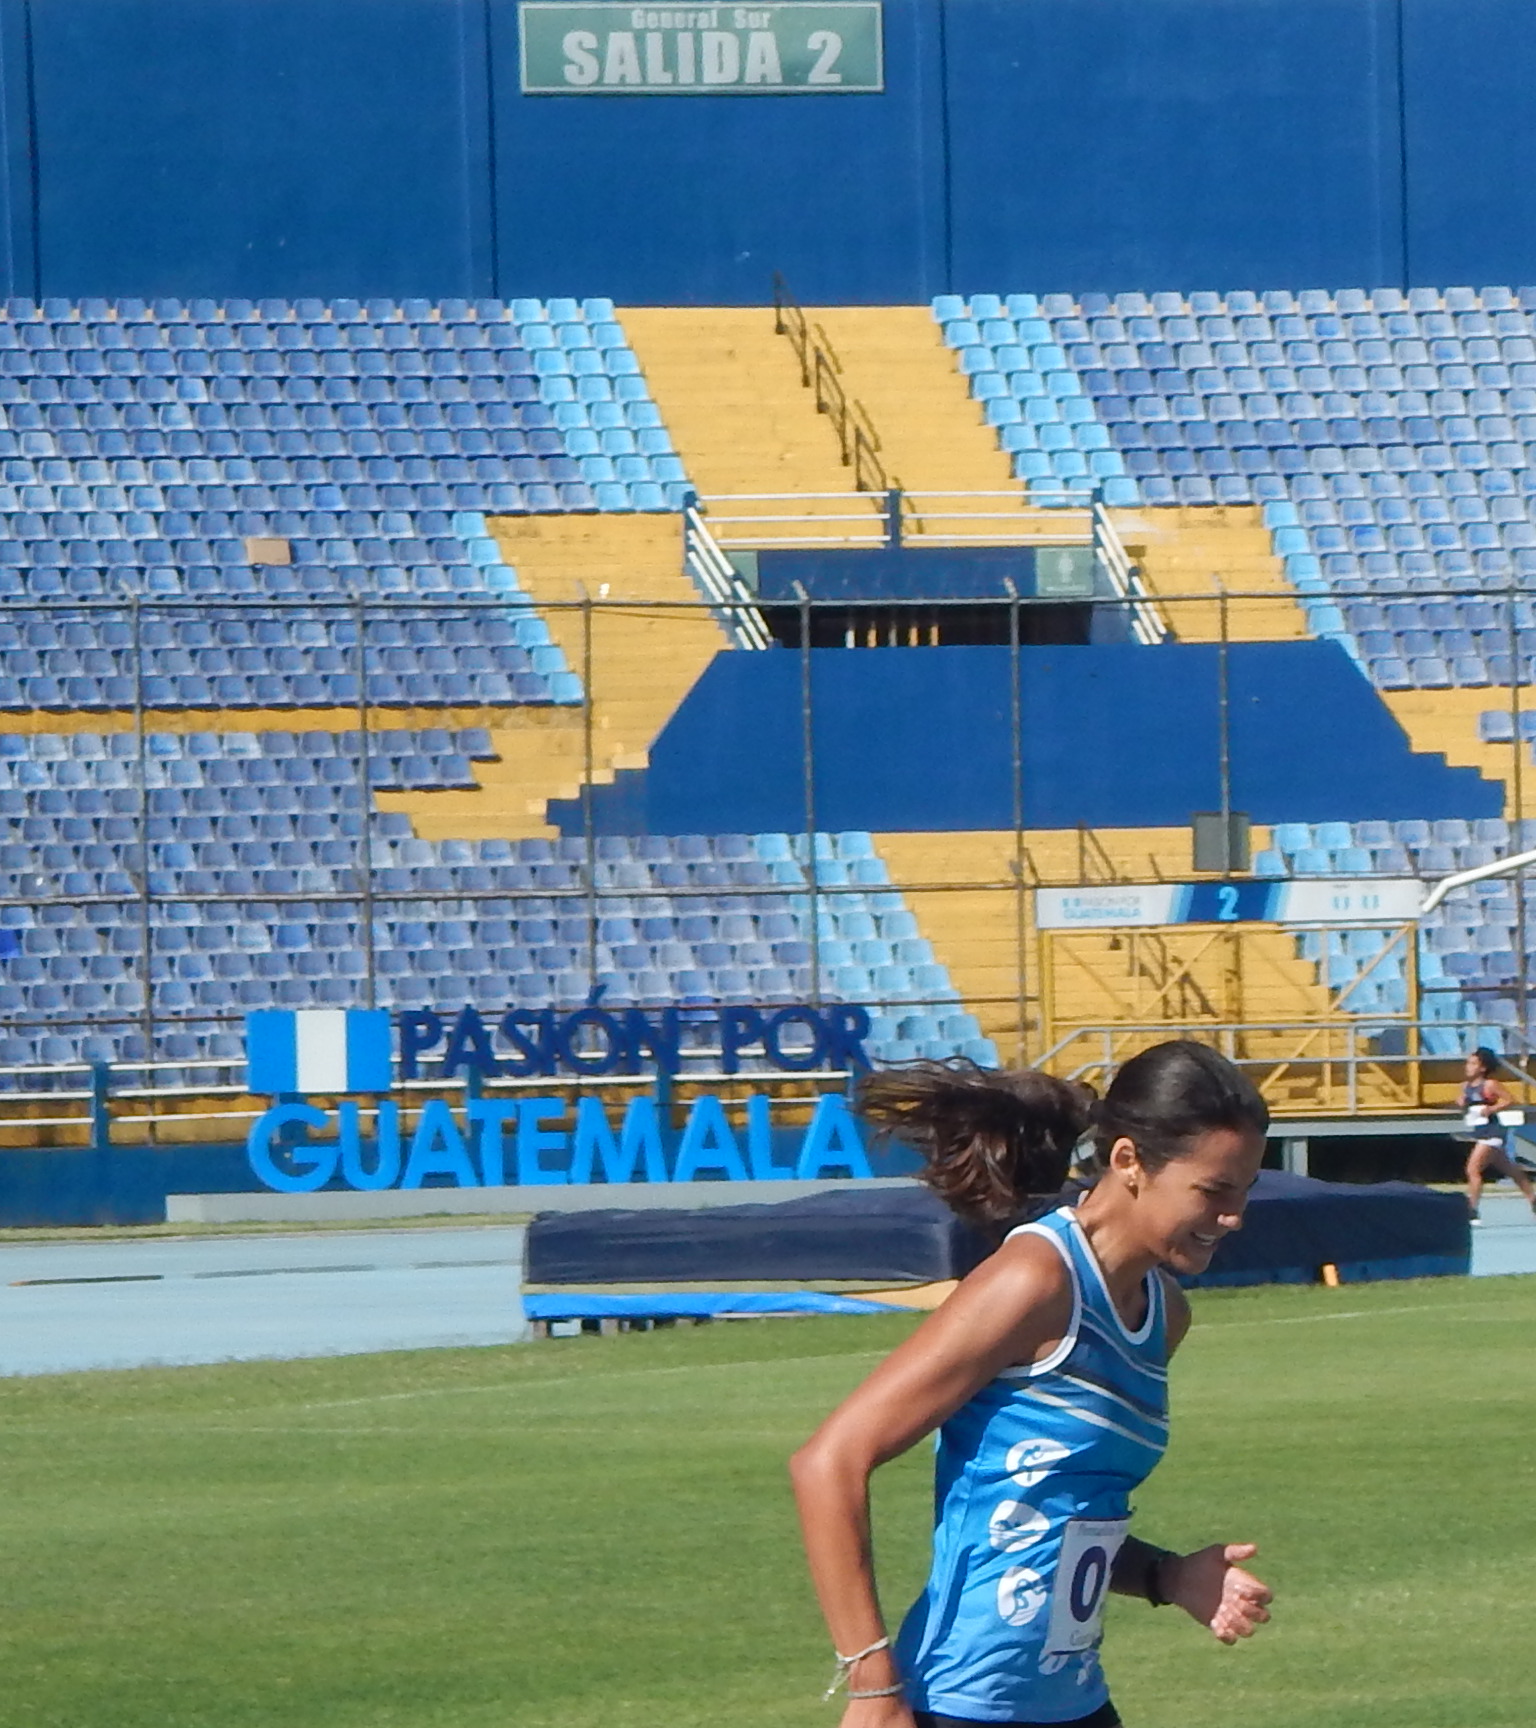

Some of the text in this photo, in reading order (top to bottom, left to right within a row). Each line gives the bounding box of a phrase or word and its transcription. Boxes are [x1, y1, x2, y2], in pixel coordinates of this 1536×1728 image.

[631, 9, 771, 29] General Sur
[562, 31, 843, 85] SALIDA 2
[1219, 886, 1239, 920] 2
[399, 984, 873, 1078] PASIÓN POR
[248, 1094, 874, 1194] GUATEMALA
